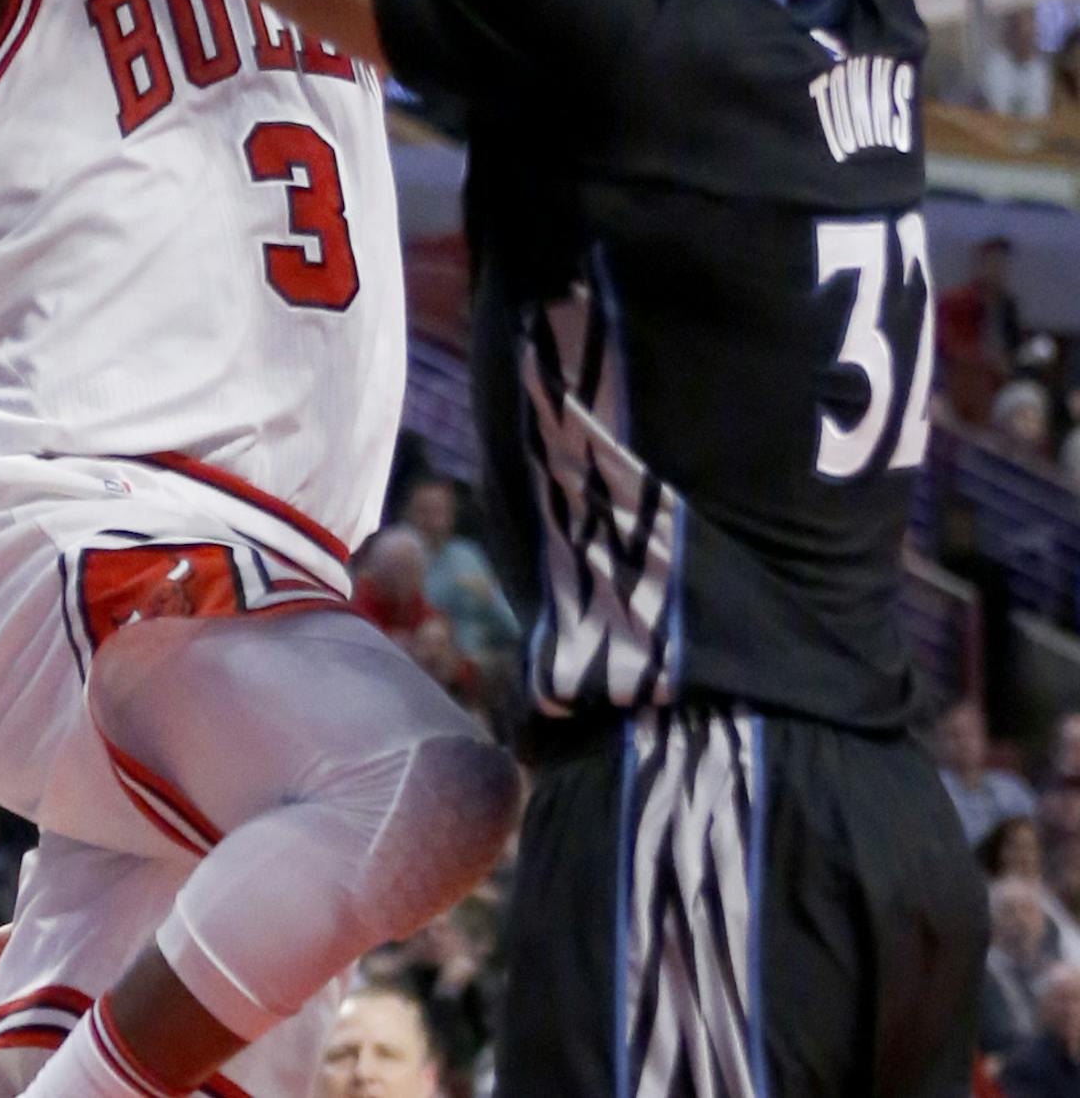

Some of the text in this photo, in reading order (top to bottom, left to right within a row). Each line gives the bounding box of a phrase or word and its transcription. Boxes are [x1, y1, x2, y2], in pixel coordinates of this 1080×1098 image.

[808, 56, 914, 162] TOWNS
[242, 121, 360, 313] 3
[816, 212, 934, 477] 32
